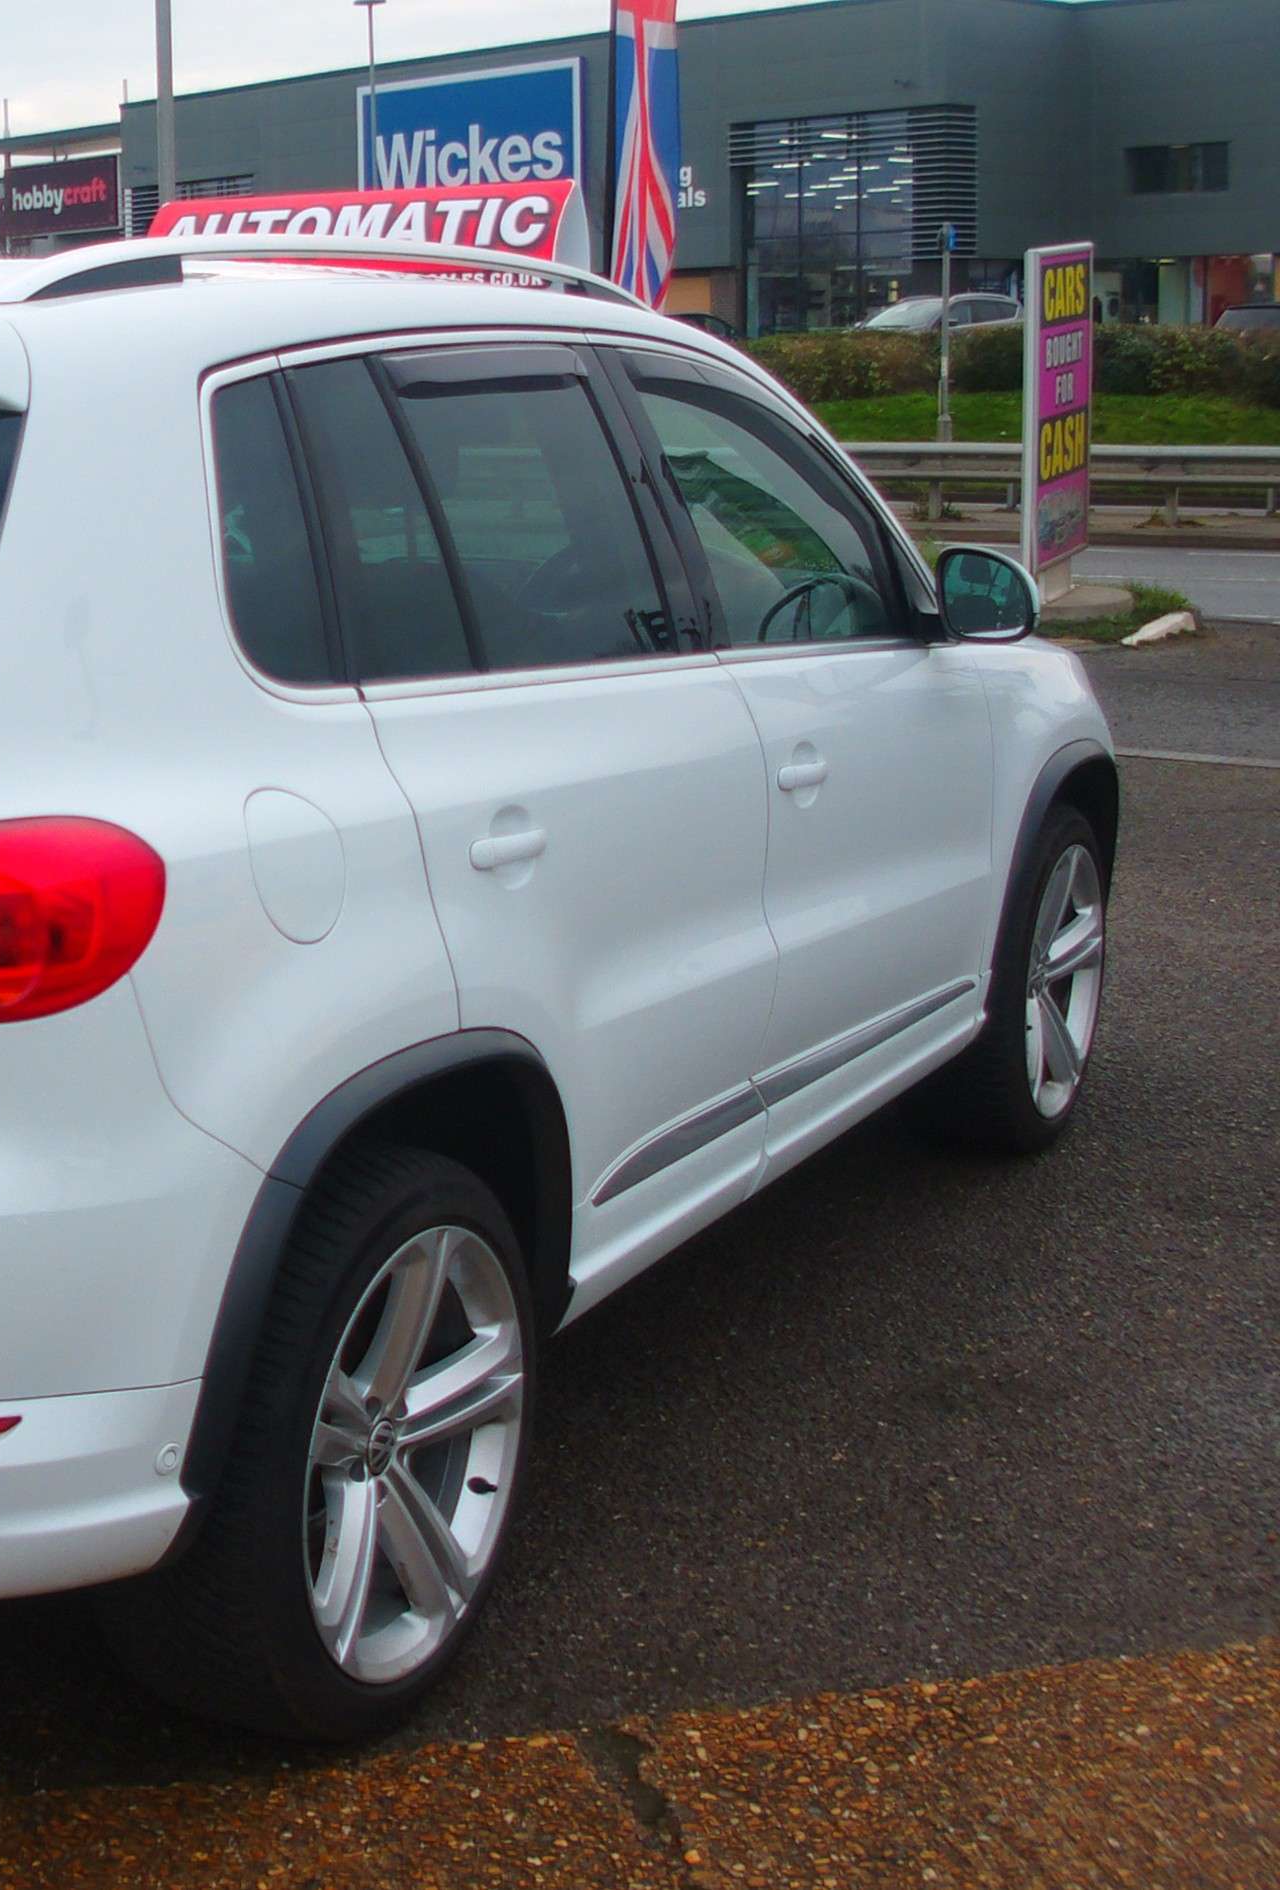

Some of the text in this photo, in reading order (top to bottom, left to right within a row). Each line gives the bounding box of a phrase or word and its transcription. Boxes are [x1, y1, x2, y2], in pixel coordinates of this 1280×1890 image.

[376, 124, 564, 191] Wickes
[12, 176, 107, 215] hobbycraft
[168, 195, 550, 248] AUTOMATIC
[1043, 263, 1086, 322] CARS
[1045, 330, 1083, 369] BOUGHT
[1055, 372, 1074, 405] FOR
[1039, 412, 1085, 481] CASH
